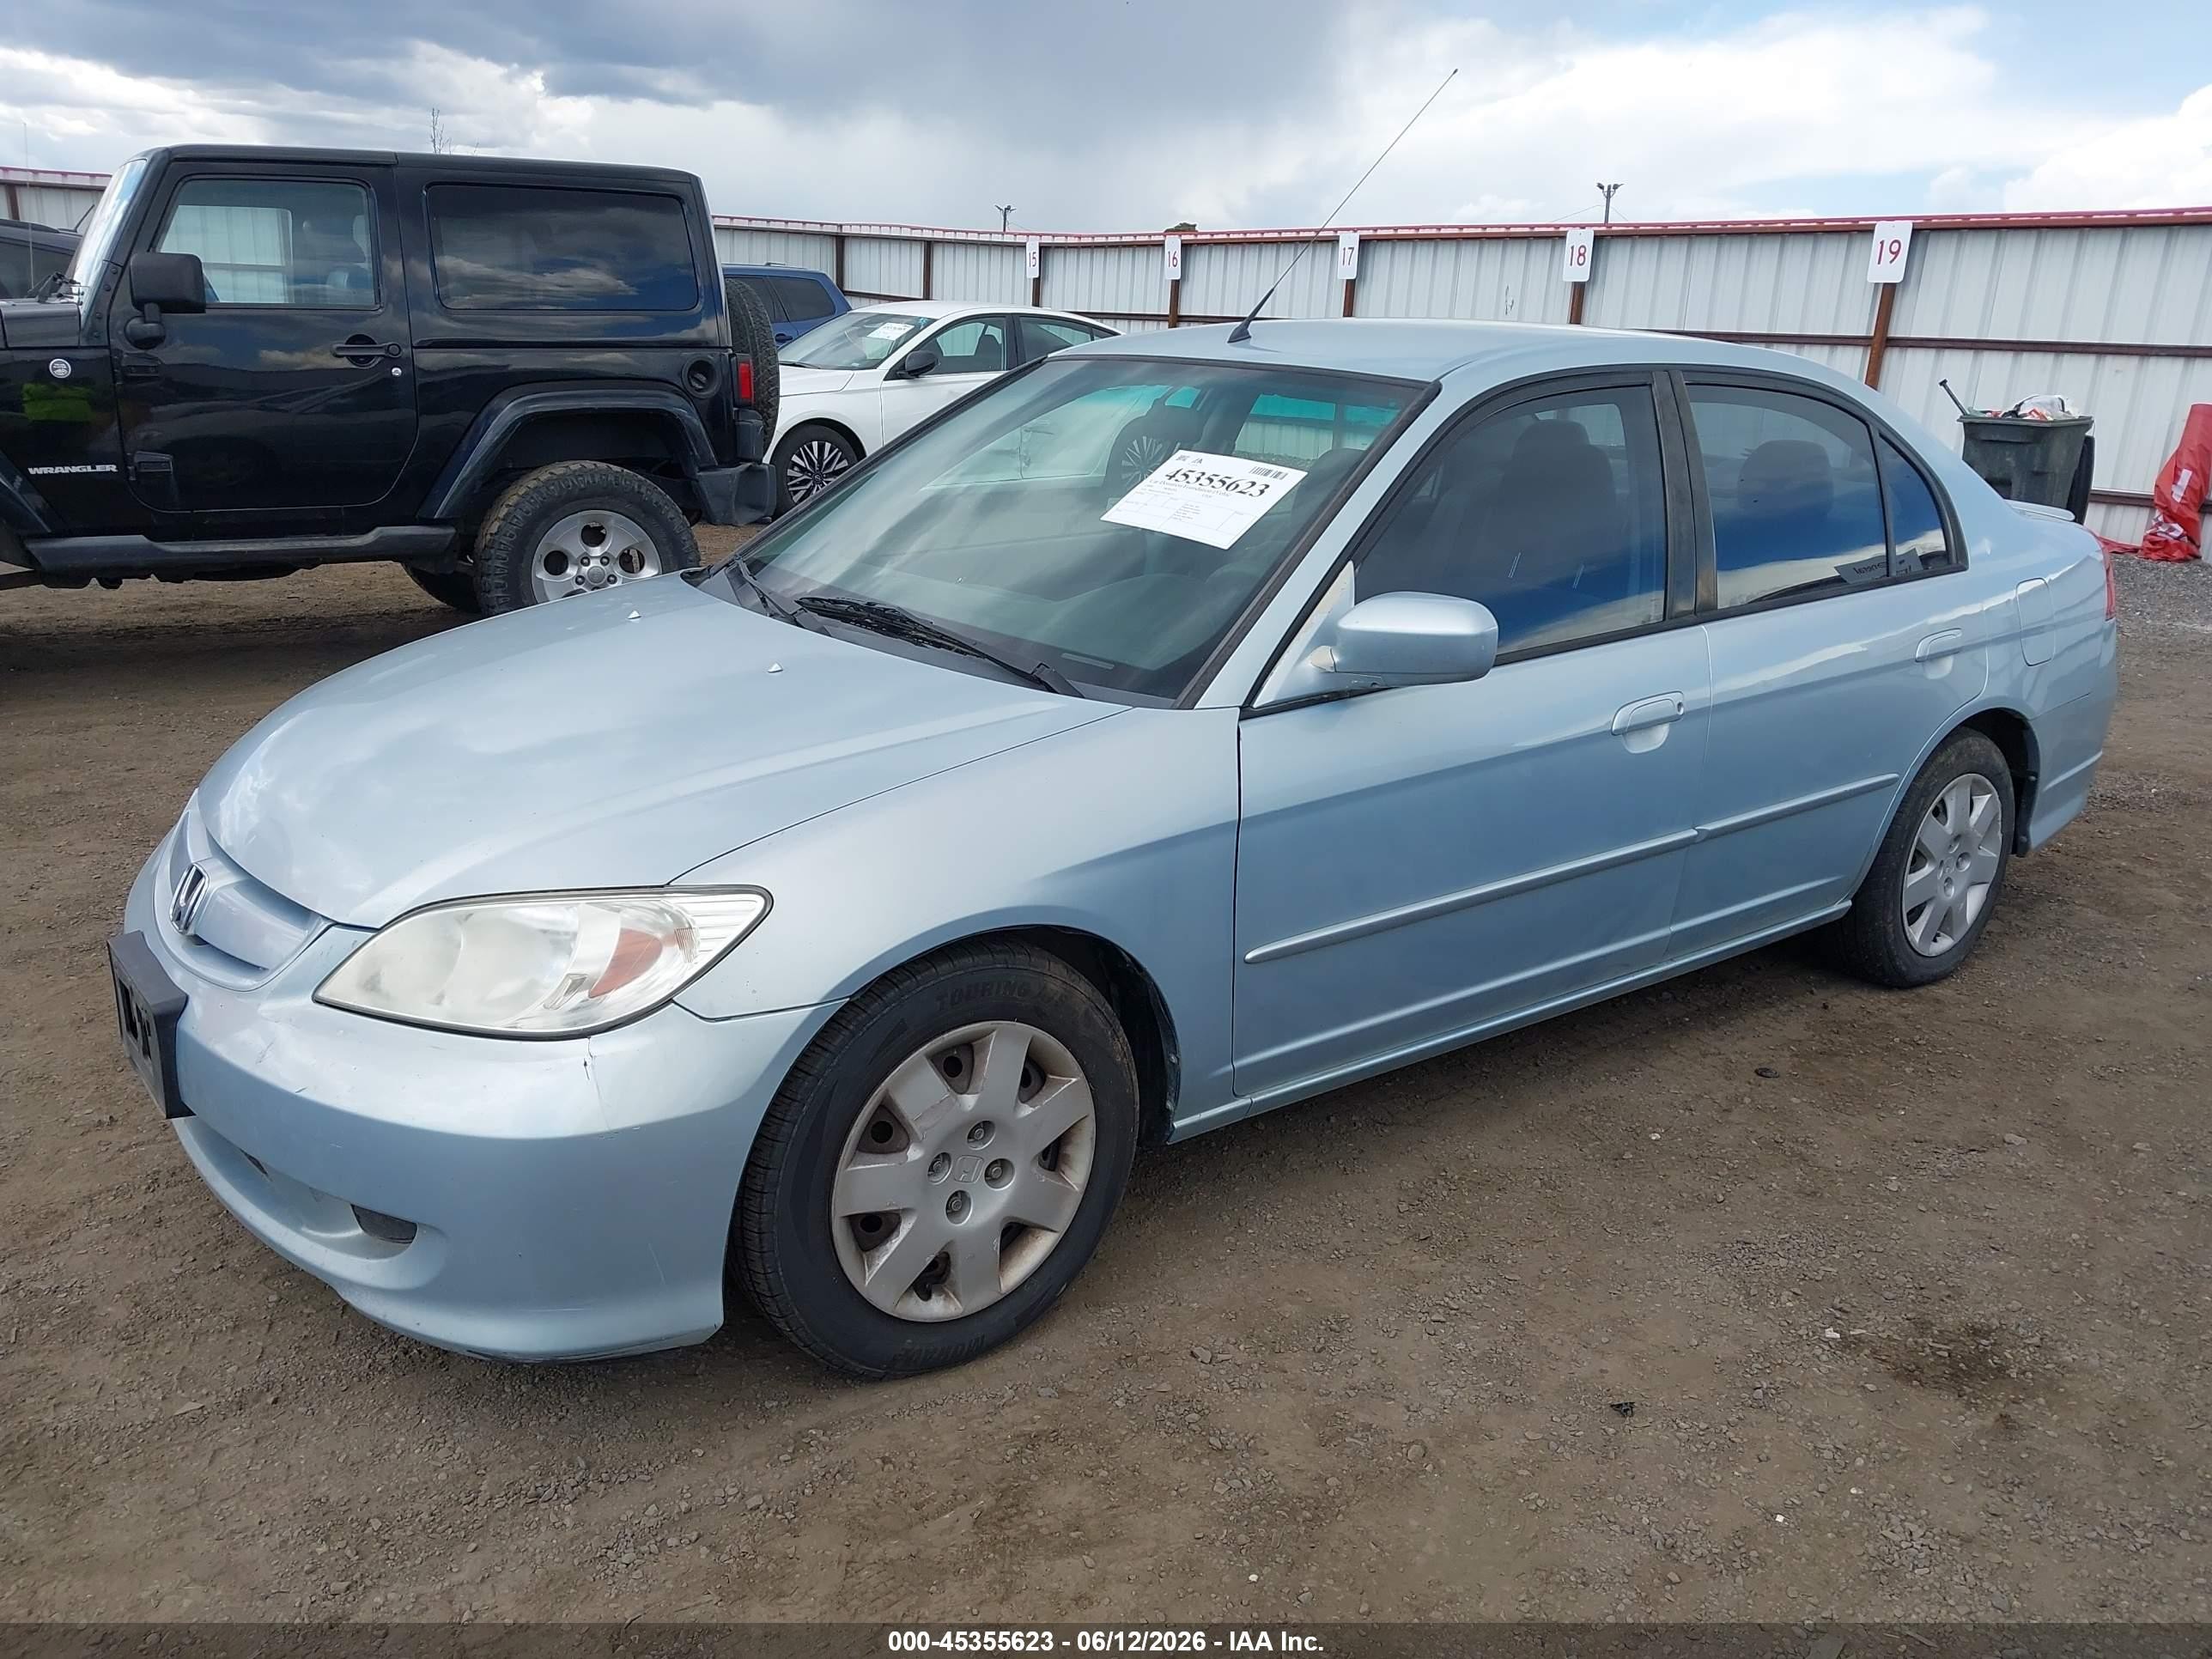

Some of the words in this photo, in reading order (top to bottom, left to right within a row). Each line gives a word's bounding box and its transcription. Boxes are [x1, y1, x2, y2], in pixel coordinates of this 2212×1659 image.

[1029, 251, 1036, 268] 15
[1167, 251, 1178, 268] 16
[1342, 246, 1355, 266] 17
[1570, 244, 1587, 266] 18
[1877, 239, 1902, 265] 19
[27, 464, 118, 475] WRANGLER
[1164, 467, 1271, 498] 45355623
